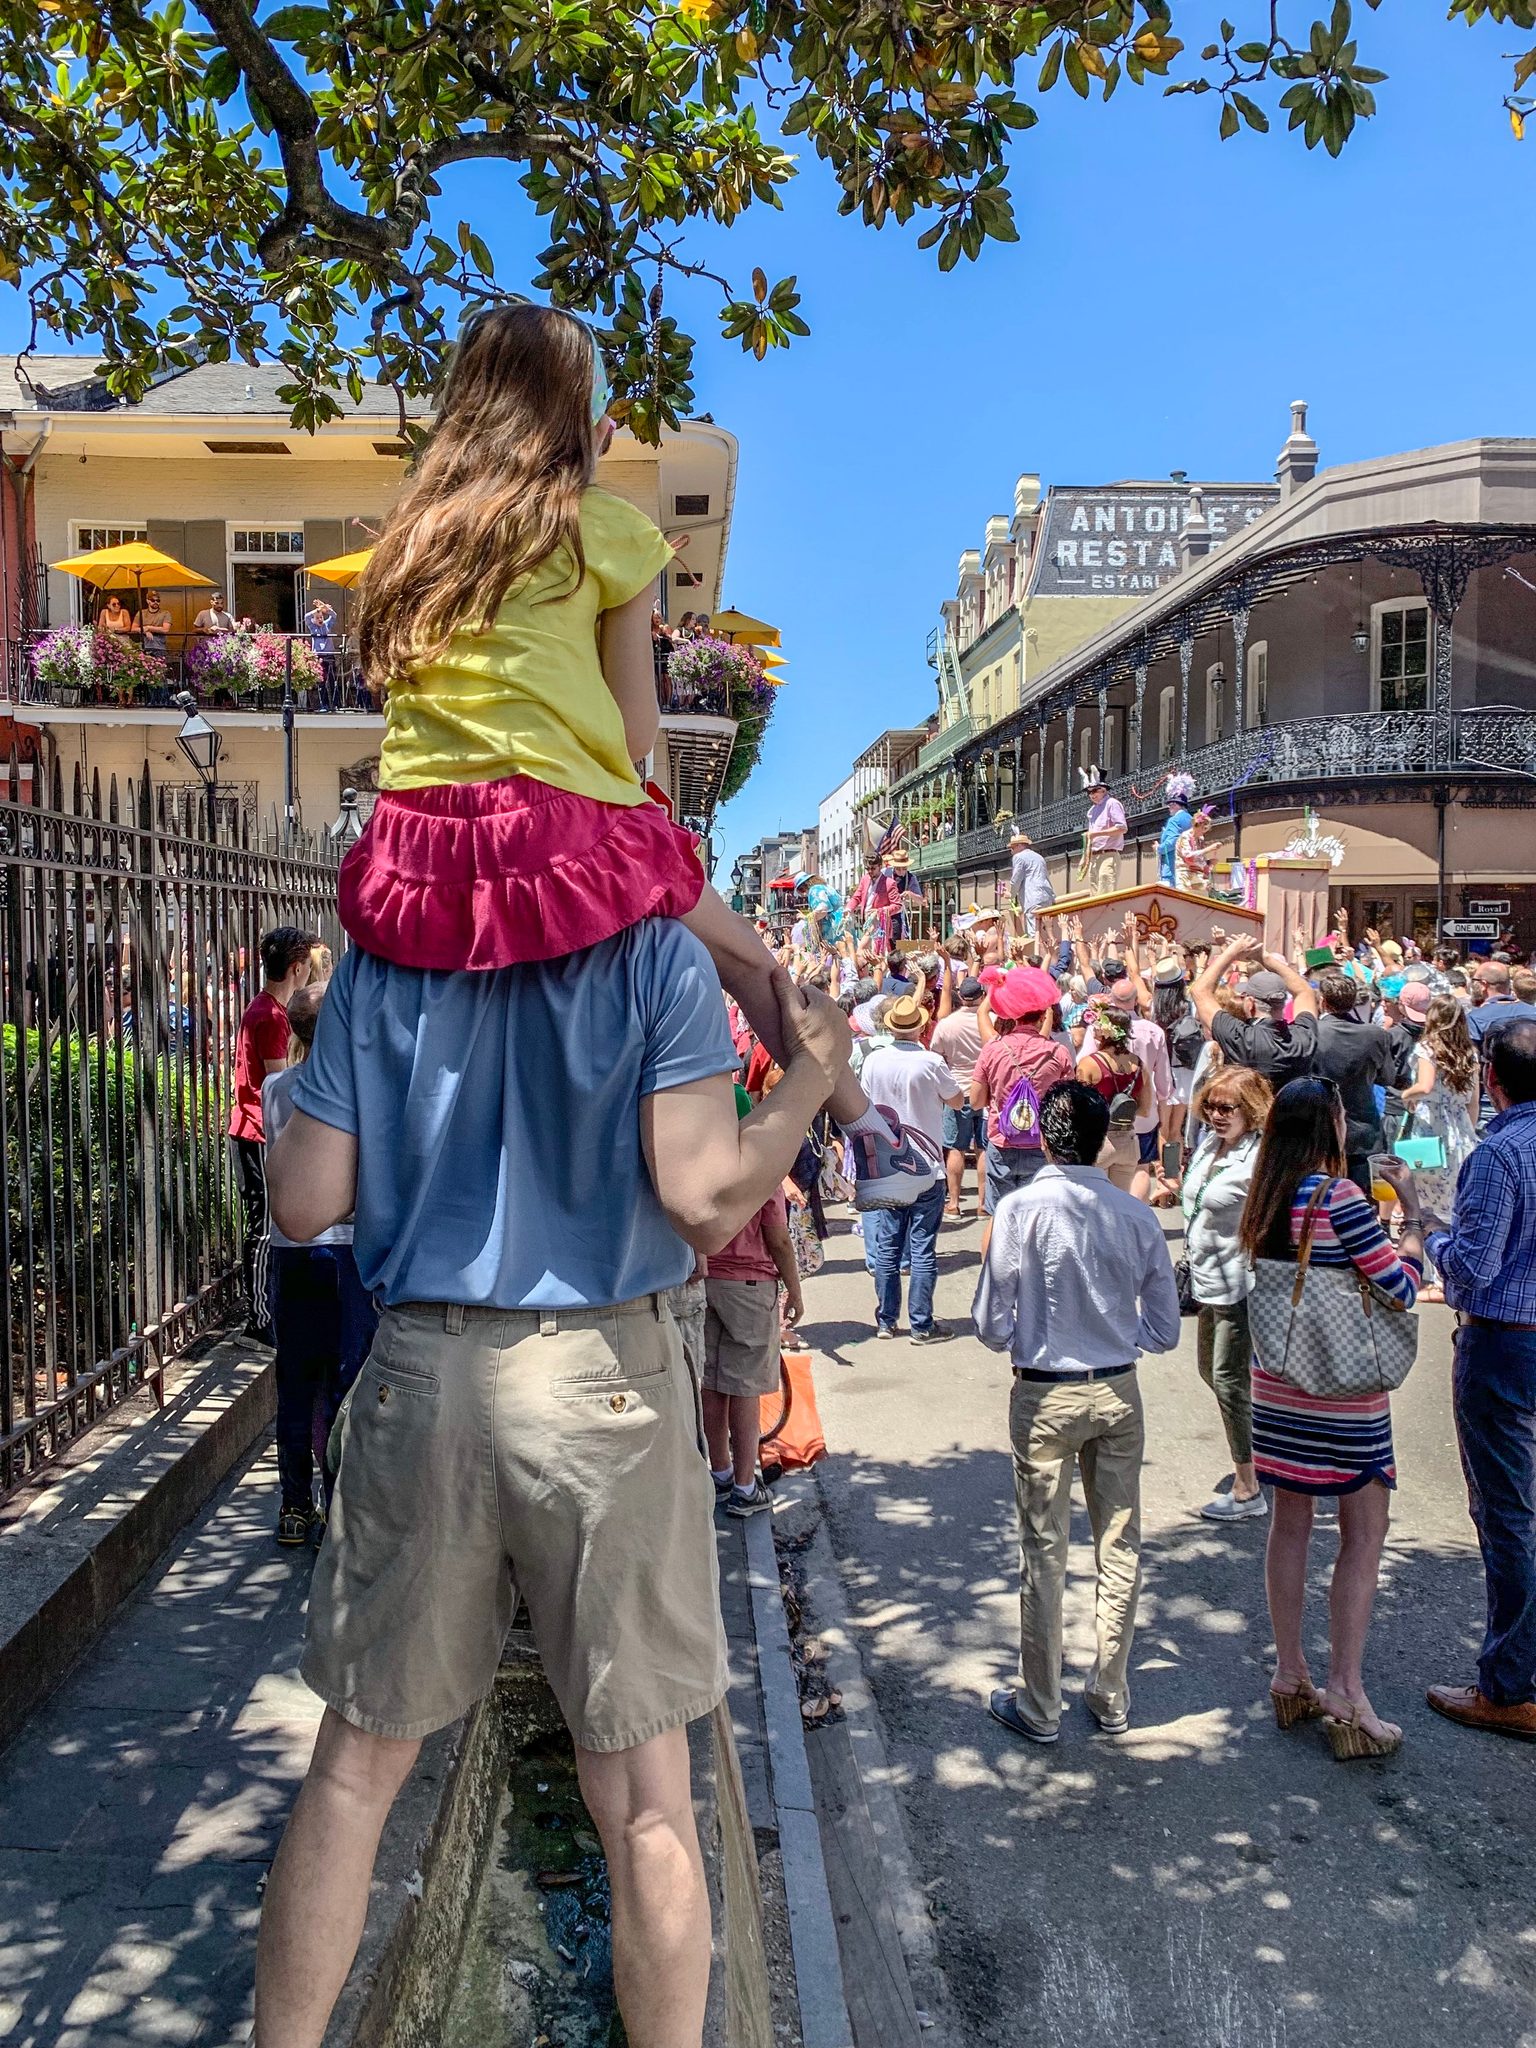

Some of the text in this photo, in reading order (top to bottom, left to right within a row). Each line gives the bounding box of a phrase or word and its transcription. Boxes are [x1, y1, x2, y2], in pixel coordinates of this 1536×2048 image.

[1091, 574, 1172, 589] ESTABL
[1455, 924, 1492, 932] ONE WAY
